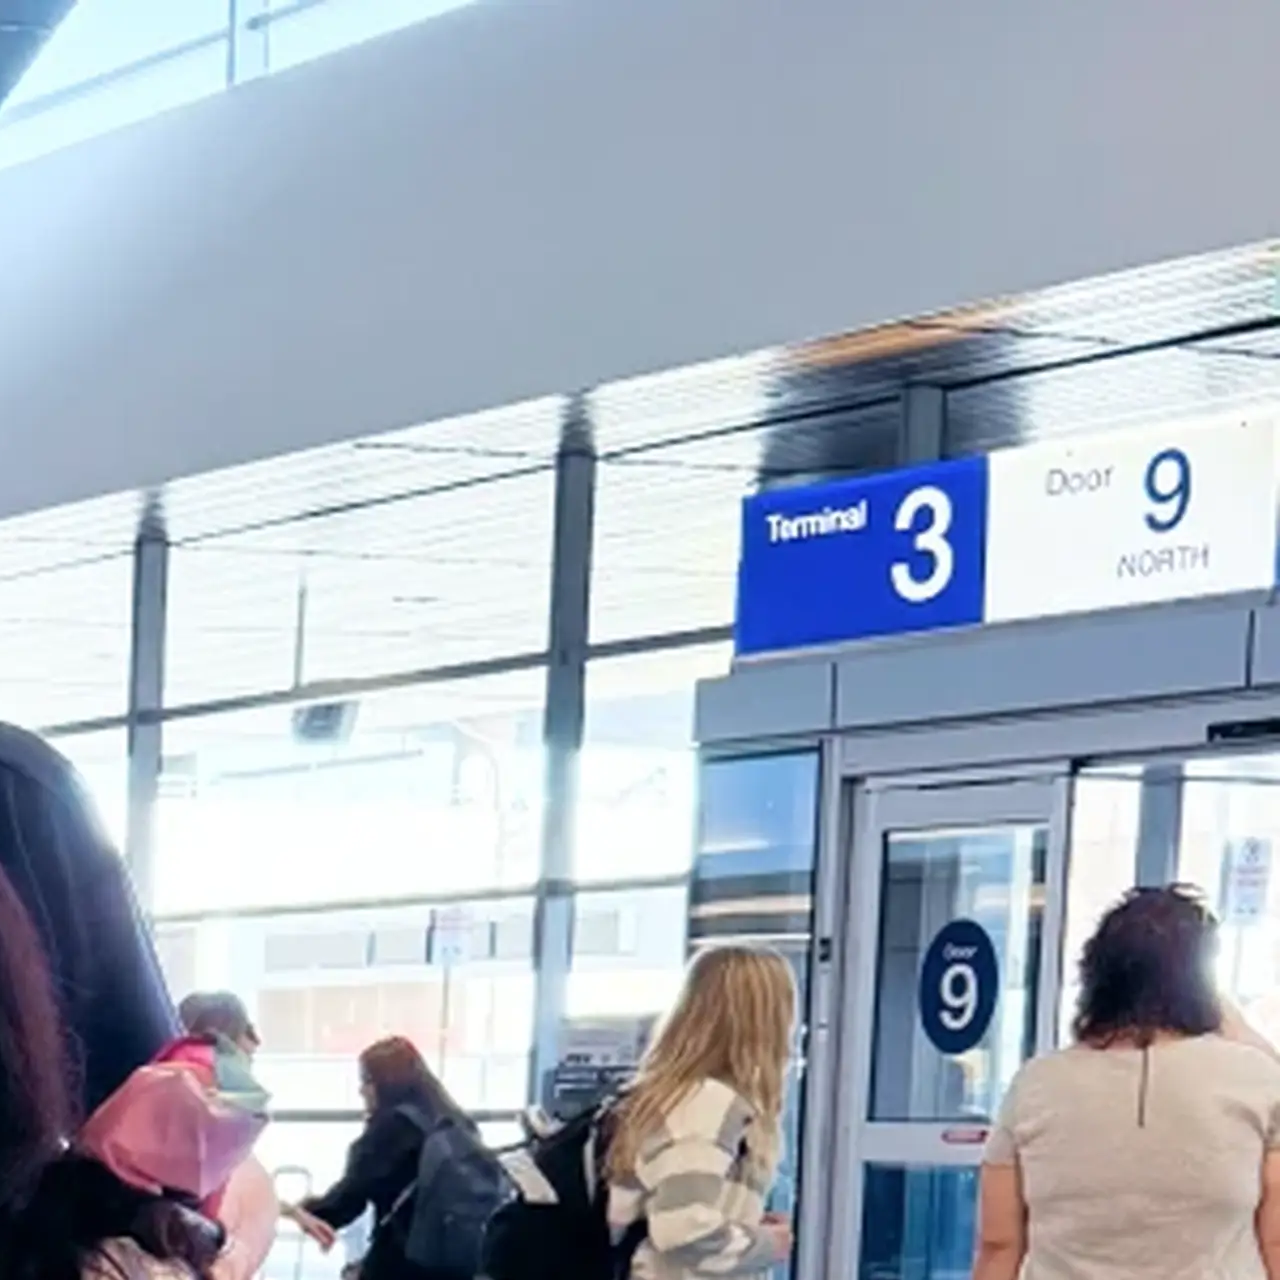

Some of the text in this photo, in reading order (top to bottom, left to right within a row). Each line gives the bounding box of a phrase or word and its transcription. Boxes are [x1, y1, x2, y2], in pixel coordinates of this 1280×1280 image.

[1045, 447, 1192, 533] Door 9
[765, 485, 953, 602] Terminal 3
[1117, 543, 1210, 578] NORTH
[939, 963, 978, 1030] 9
